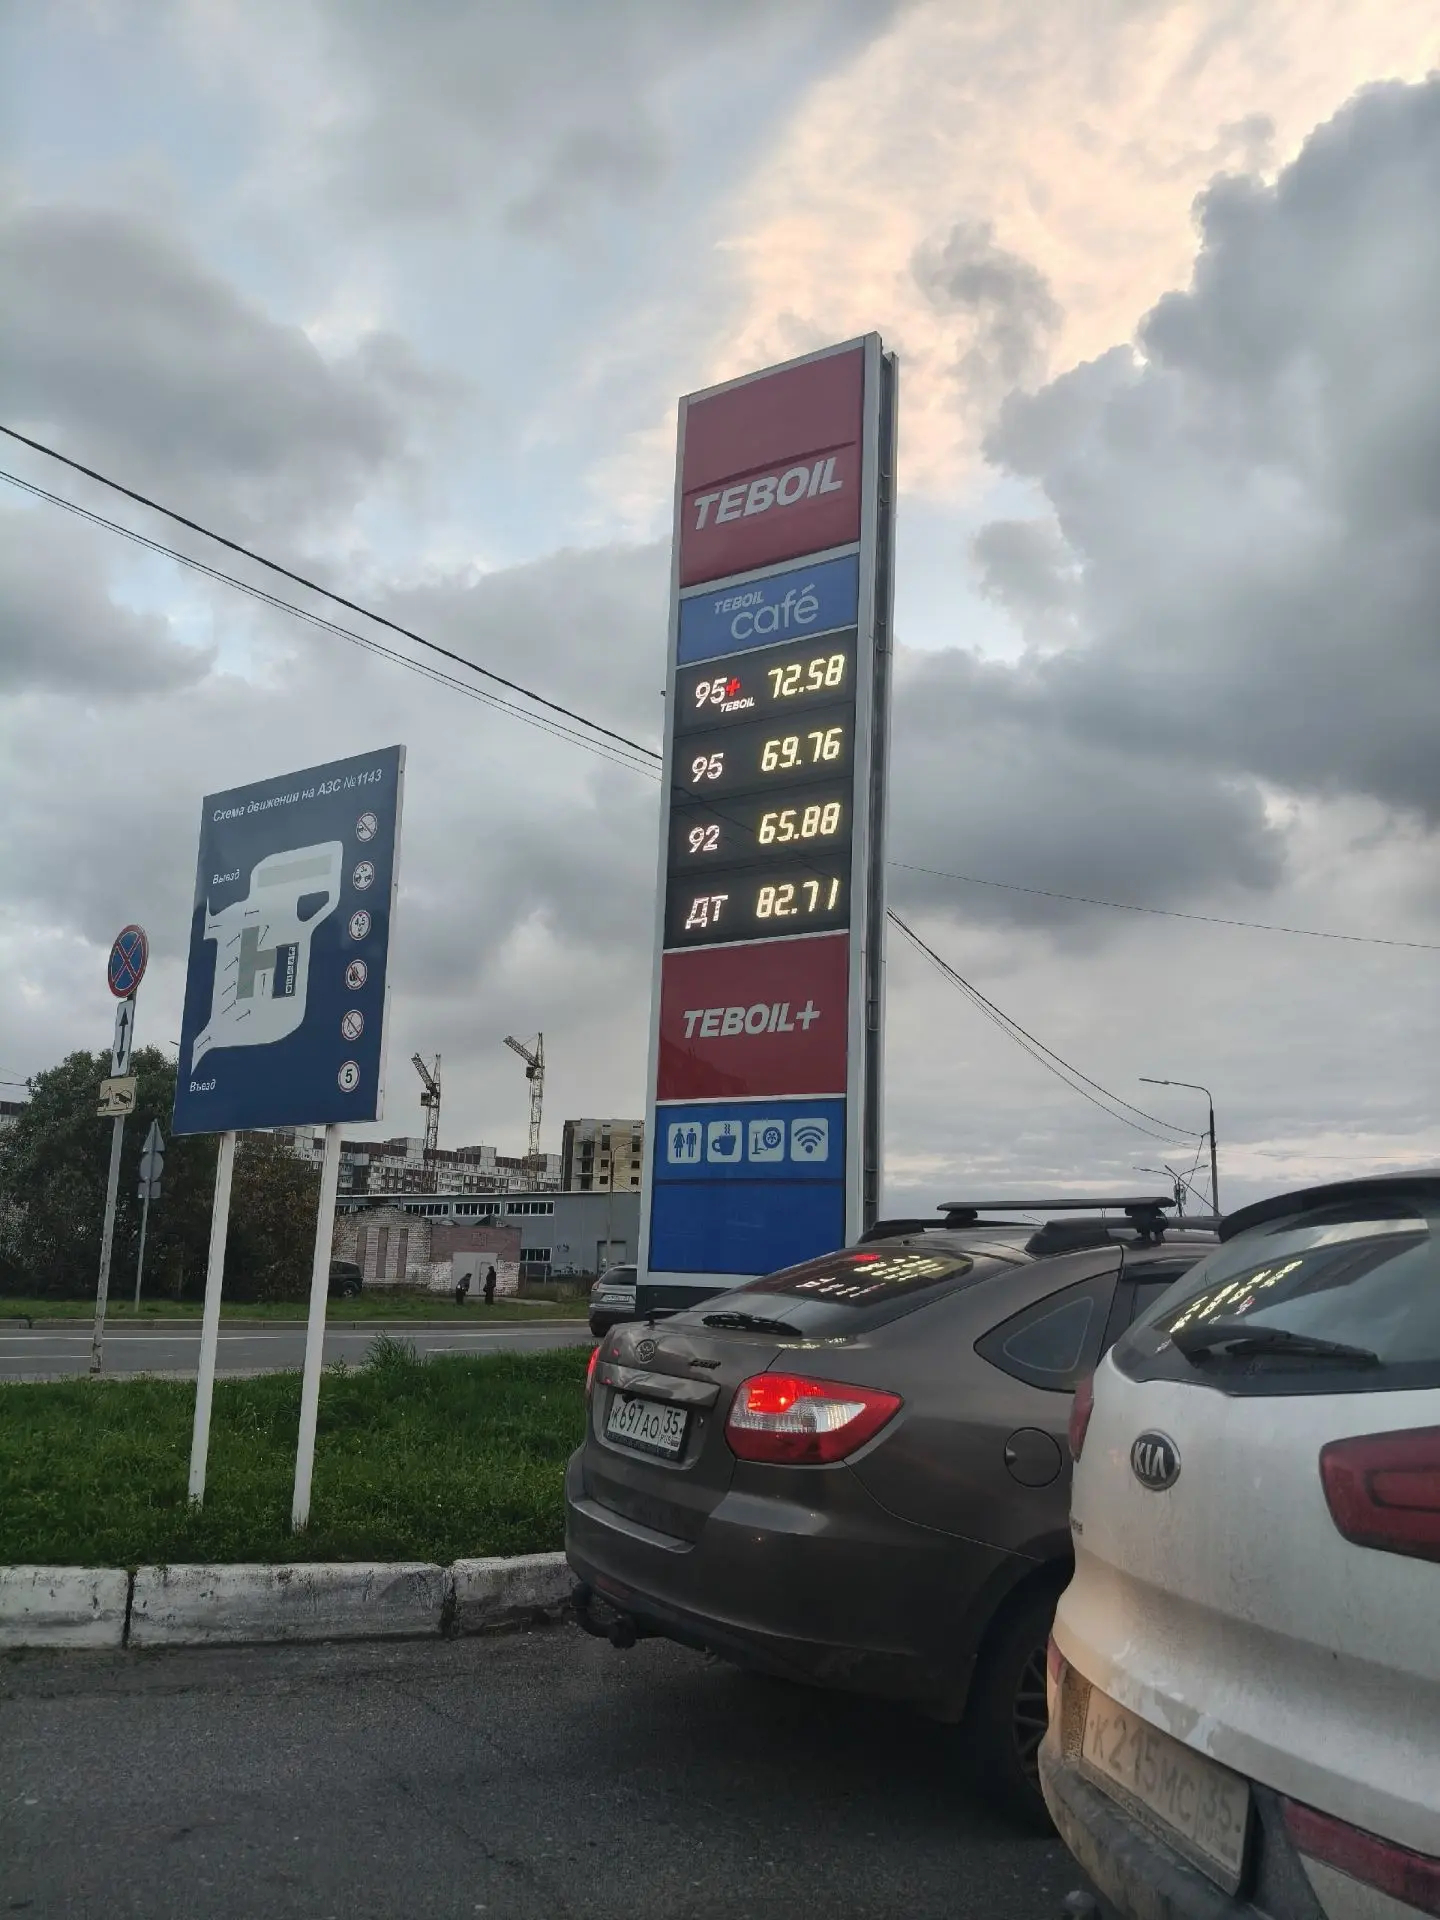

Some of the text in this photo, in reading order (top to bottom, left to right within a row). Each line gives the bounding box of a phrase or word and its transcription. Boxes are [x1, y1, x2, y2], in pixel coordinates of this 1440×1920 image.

[694, 457, 843, 530] TEBOIL
[714, 590, 765, 614] TEBOIL
[731, 583, 818, 640] café
[767, 654, 846, 698] 72.58
[720, 696, 755, 713] TEBOIL
[691, 727, 843, 783] 95 69.76
[212, 805, 246, 822] Схема
[246, 791, 300, 814] движения
[301, 787, 315, 801] на
[316, 778, 342, 796] АЗС
[688, 802, 841, 853] 92 65.88
[212, 868, 241, 885] Выезд
[684, 877, 839, 930] ДТ 82.71
[683, 999, 821, 1039] TEBOIL+
[189, 1078, 217, 1092] Въезд
[344, 1068, 354, 1084] 5
[663, 1410, 681, 1435] 35
[1134, 1442, 1167, 1478] KIA
[1203, 1778, 1236, 1832] 35
